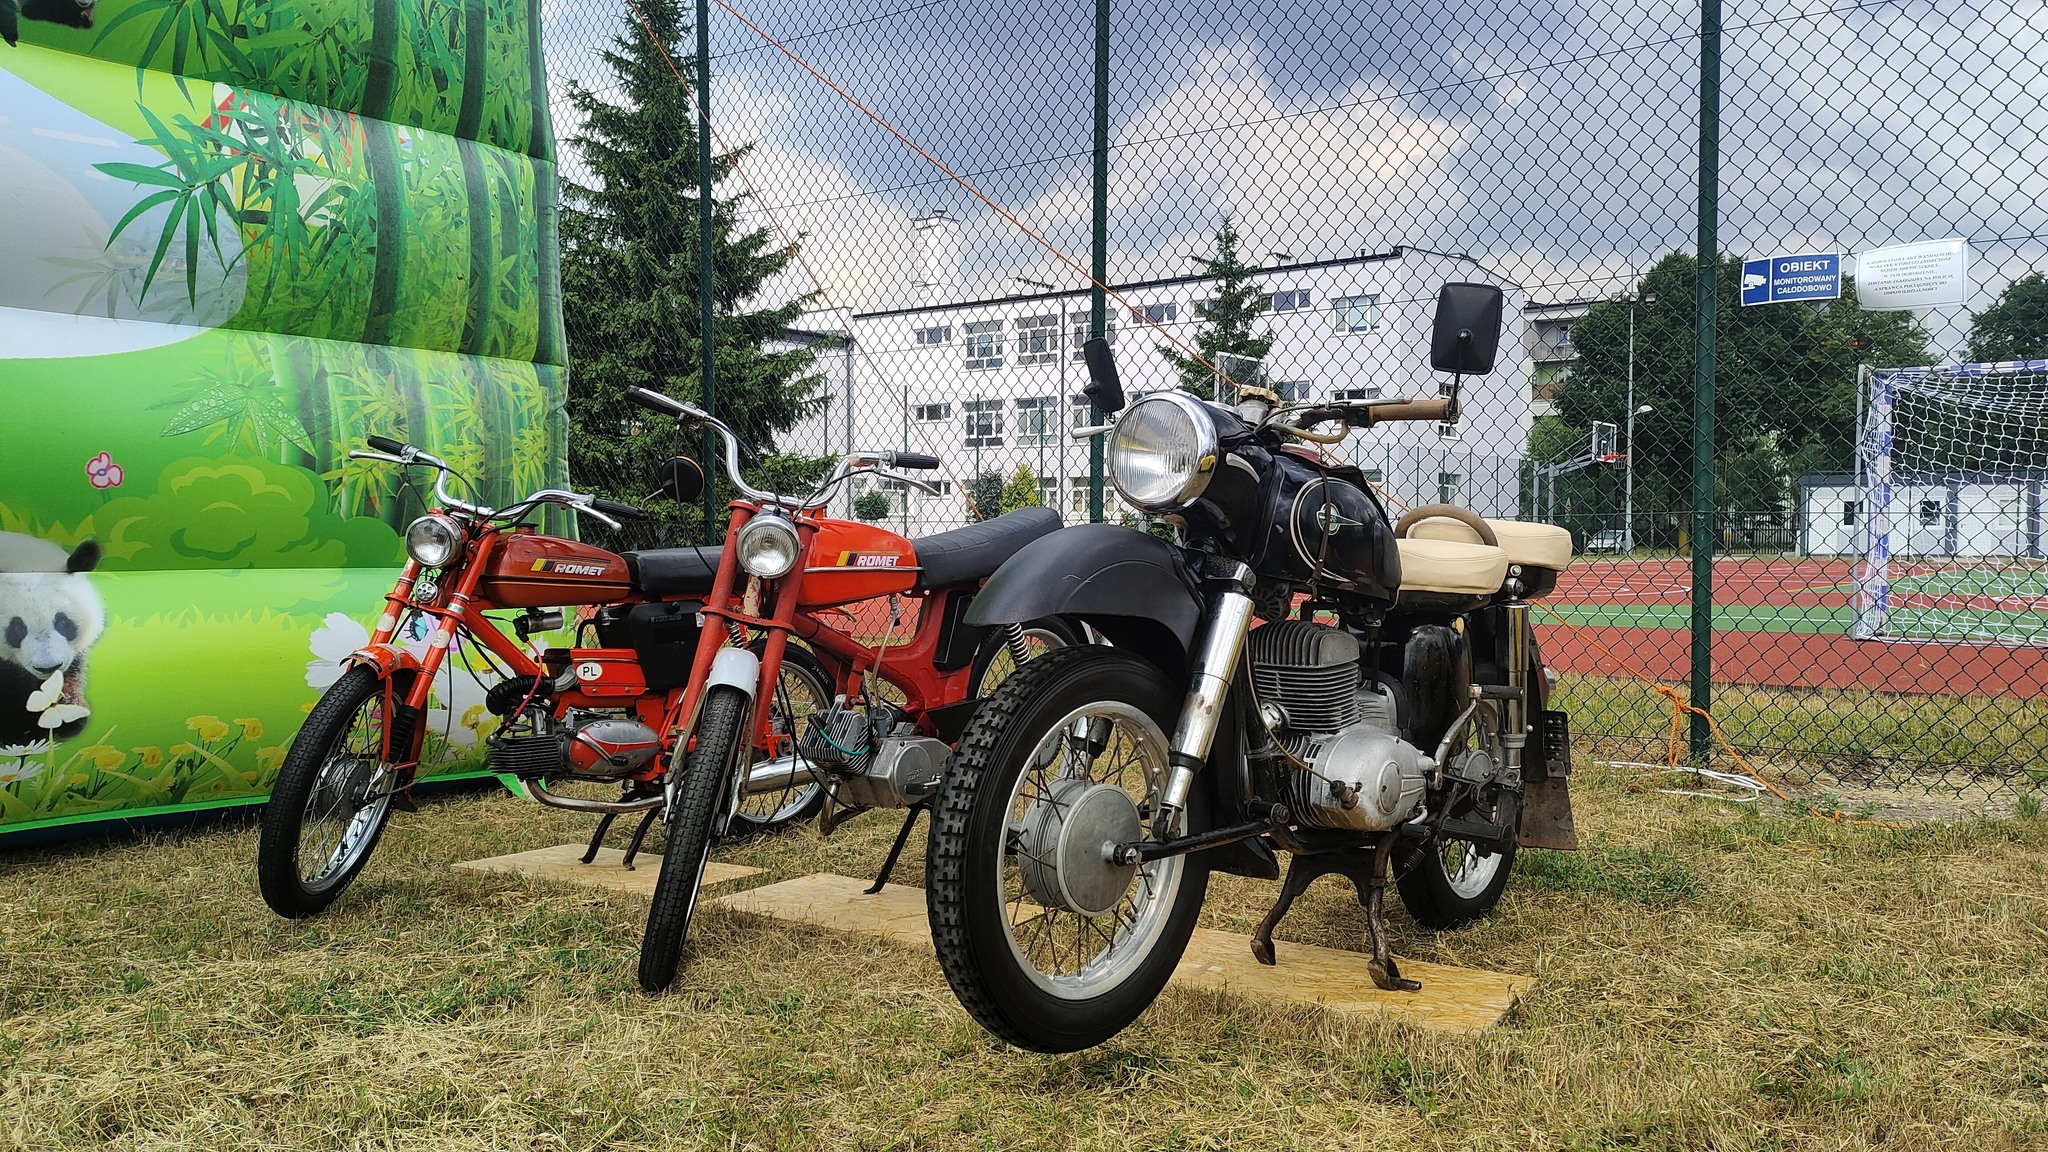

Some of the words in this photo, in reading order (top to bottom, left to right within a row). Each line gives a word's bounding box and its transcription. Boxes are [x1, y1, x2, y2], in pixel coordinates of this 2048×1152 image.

[1780, 260, 1831, 273] OBIEKT
[1774, 275, 1837, 286] MONITOROWANY
[1777, 284, 1832, 295] CAŁODOBOWO
[857, 555, 900, 567] ROMET
[554, 563, 606, 576] ROMET
[582, 666, 597, 677] PL
